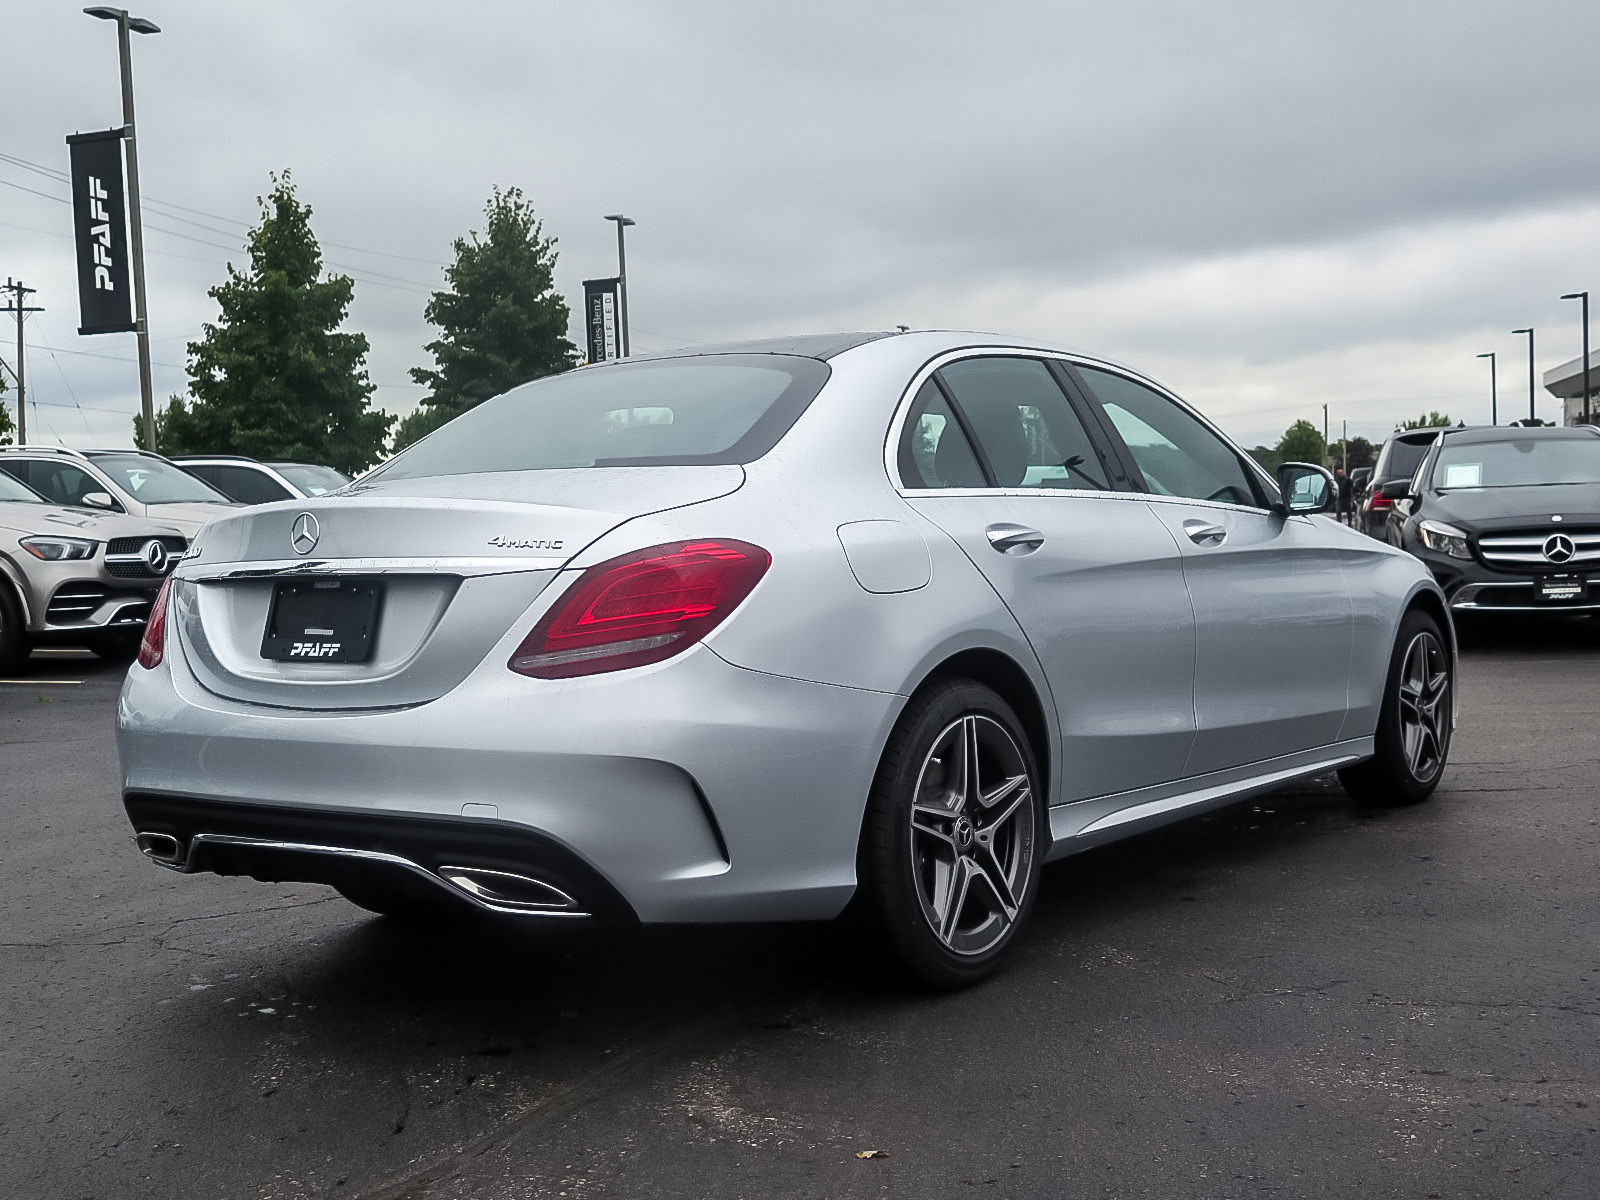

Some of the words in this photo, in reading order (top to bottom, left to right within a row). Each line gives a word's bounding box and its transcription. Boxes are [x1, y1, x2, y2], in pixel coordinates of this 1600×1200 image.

[89, 176, 114, 291] PFAFF
[593, 298, 604, 362] rcedes-Benz
[605, 297, 614, 357] RTIFIED
[487, 534, 564, 550] 4MATIC
[289, 642, 341, 657] PFAFF
